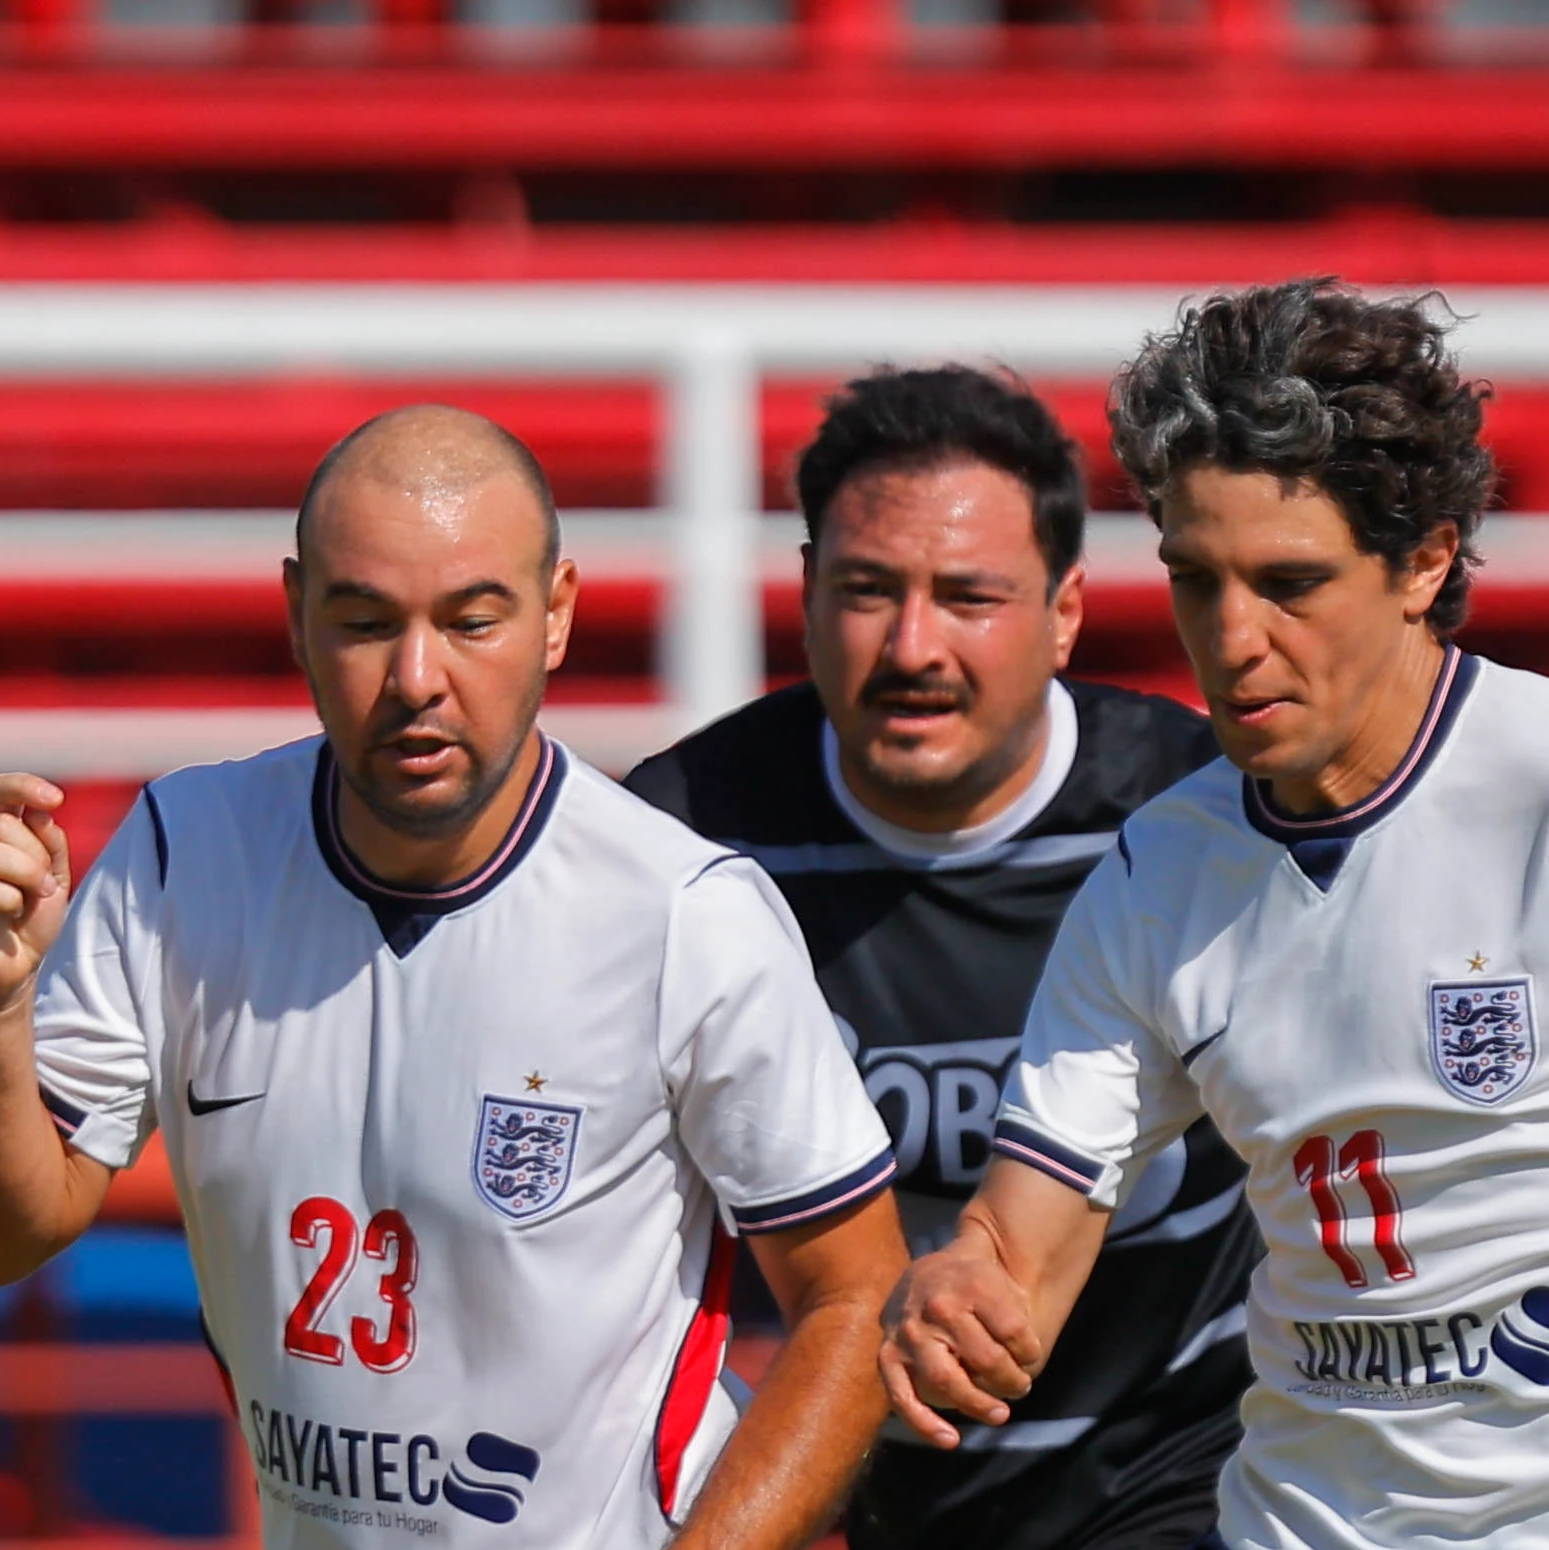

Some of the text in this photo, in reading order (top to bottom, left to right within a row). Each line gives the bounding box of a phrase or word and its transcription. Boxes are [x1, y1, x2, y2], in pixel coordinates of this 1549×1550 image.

[1293, 1130, 1416, 1288] 11
[284, 1196, 419, 1374] 23
[1293, 1312, 1488, 1387] SAYATEC
[251, 1399, 439, 1506] SAYATEC
[342, 1507, 373, 1527] para
[377, 1511, 392, 1528] tu
[396, 1512, 438, 1537] Hogar
